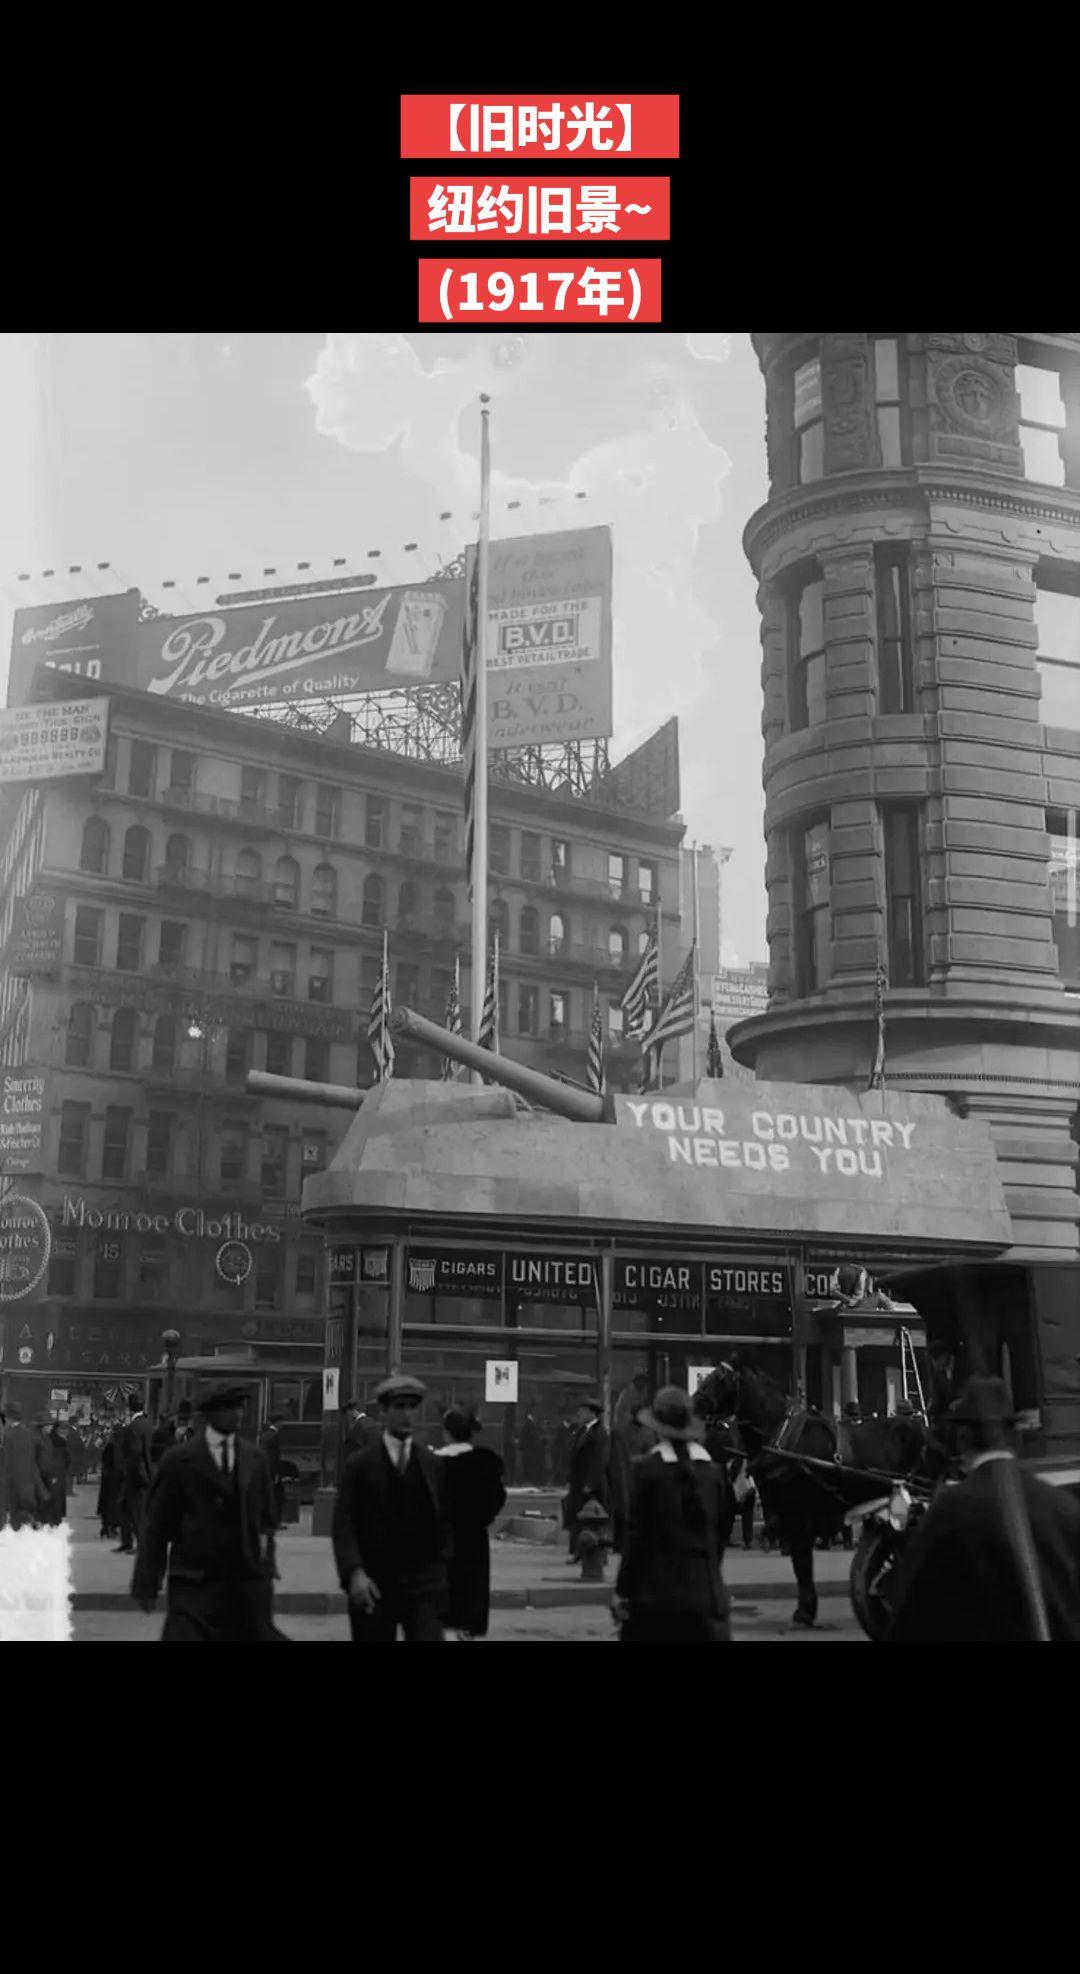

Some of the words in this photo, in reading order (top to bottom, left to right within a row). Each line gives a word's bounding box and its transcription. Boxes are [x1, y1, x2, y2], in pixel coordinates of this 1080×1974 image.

[488, 608, 529, 622] MADE
[532, 604, 556, 617] FOR
[563, 600, 589, 613] THE
[147, 594, 392, 694] Piedmont
[504, 621, 575, 650] B.V.D.
[486, 656, 513, 669] BEST
[517, 650, 555, 665] RETAIL
[557, 646, 591, 661] TRADE
[180, 692, 206, 706] The
[208, 684, 278, 707] Cigarette
[282, 680, 299, 694] of
[302, 672, 360, 692] Quality
[62, 704, 90, 717] MAN
[4, 1094, 42, 1114] Clothes
[625, 1101, 725, 1135] YOUR
[752, 1110, 915, 1150] COUNTRY
[668, 1135, 789, 1171] NEEDS
[811, 1145, 884, 1178] YOU
[0, 1216, 39, 1229] onroe
[62, 1195, 169, 1233] Monroe
[175, 1207, 281, 1243] Clothes
[0, 1233, 39, 1249] othes
[330, 1253, 353, 1273] ARS
[440, 1260, 496, 1277] CIGARS
[511, 1259, 592, 1286] UNITED
[624, 1265, 690, 1291] CIGAR
[710, 1268, 783, 1294] STORES
[804, 1273, 834, 1296] CO
